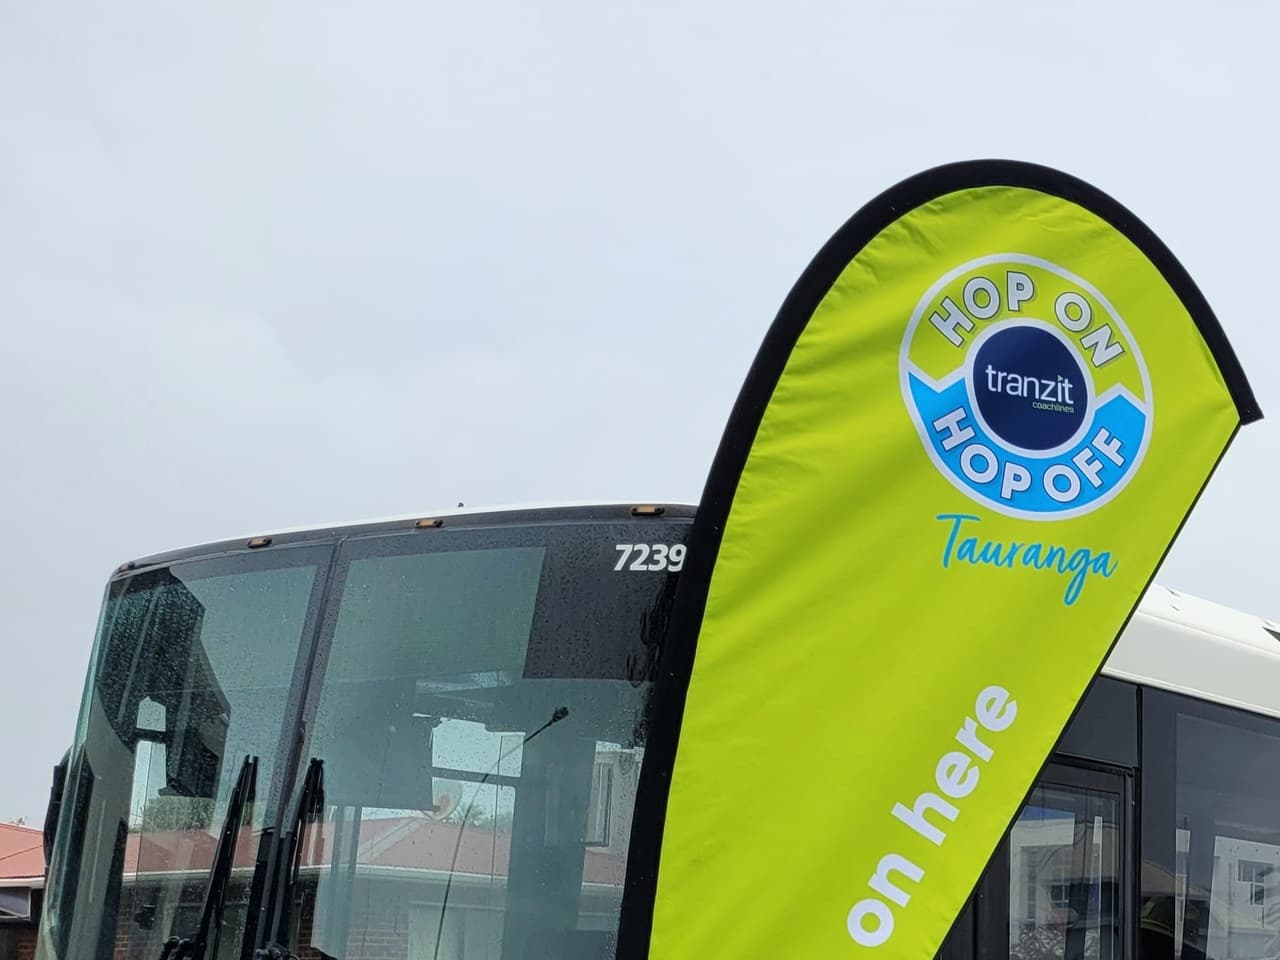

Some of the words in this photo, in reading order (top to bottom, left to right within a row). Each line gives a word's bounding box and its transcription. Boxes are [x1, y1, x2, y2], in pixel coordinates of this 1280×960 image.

[929, 271, 1035, 347] HOP
[1054, 292, 1125, 368] ON
[985, 364, 1074, 404] tranzit
[1032, 400, 1075, 413] coachlines
[932, 408, 1032, 500] HOP
[1042, 427, 1126, 502] OFF
[614, 543, 687, 572] 7239
[936, 513, 1118, 606] Tauranga
[847, 853, 926, 947] on
[890, 685, 1018, 847] here
